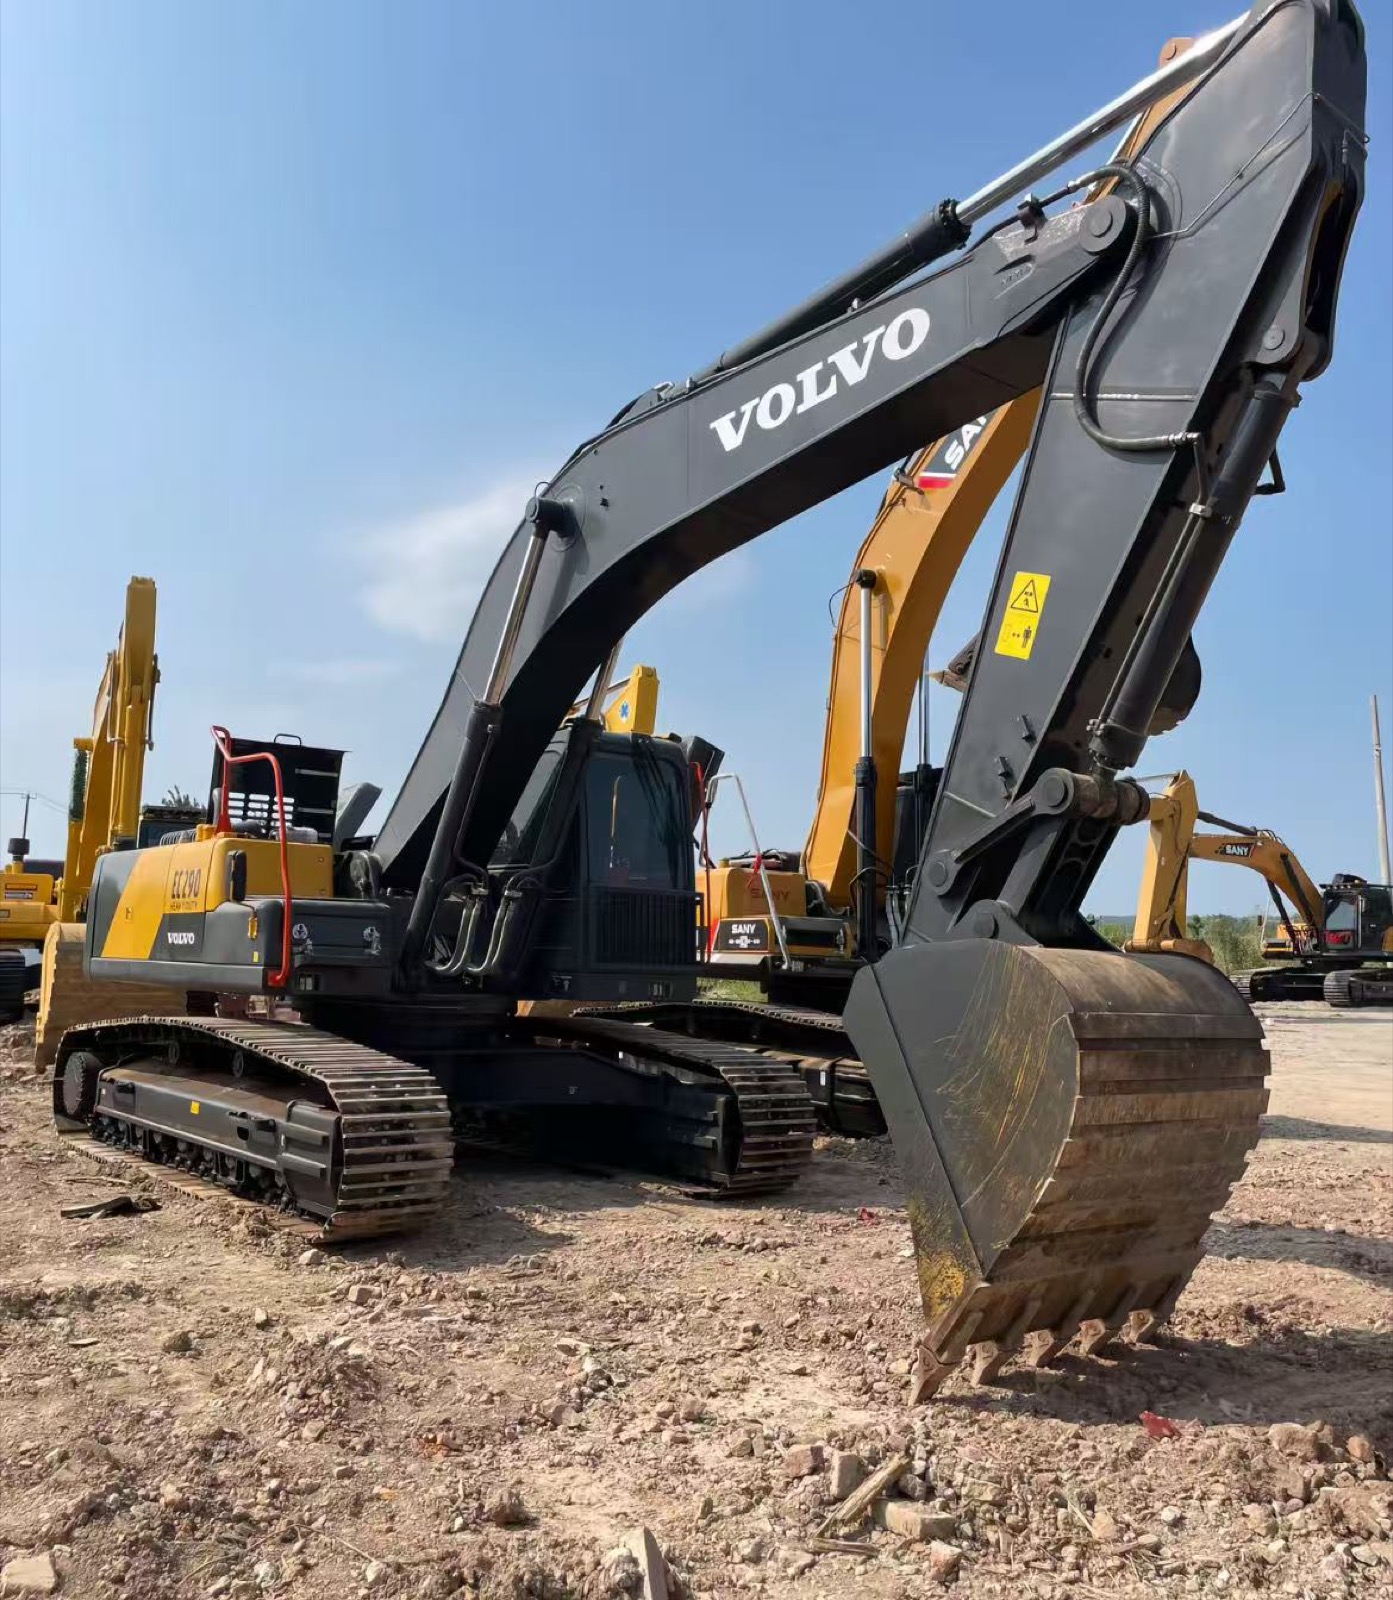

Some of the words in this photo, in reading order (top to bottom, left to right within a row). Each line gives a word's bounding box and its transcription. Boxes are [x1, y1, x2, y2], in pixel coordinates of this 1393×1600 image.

[709, 308, 931, 452] VOLVO
[944, 415, 987, 470] SA
[1225, 844, 1249, 856] SANY
[171, 869, 201, 899] EC290
[167, 932, 195, 945] VOLVO
[731, 924, 756, 934] SANY
